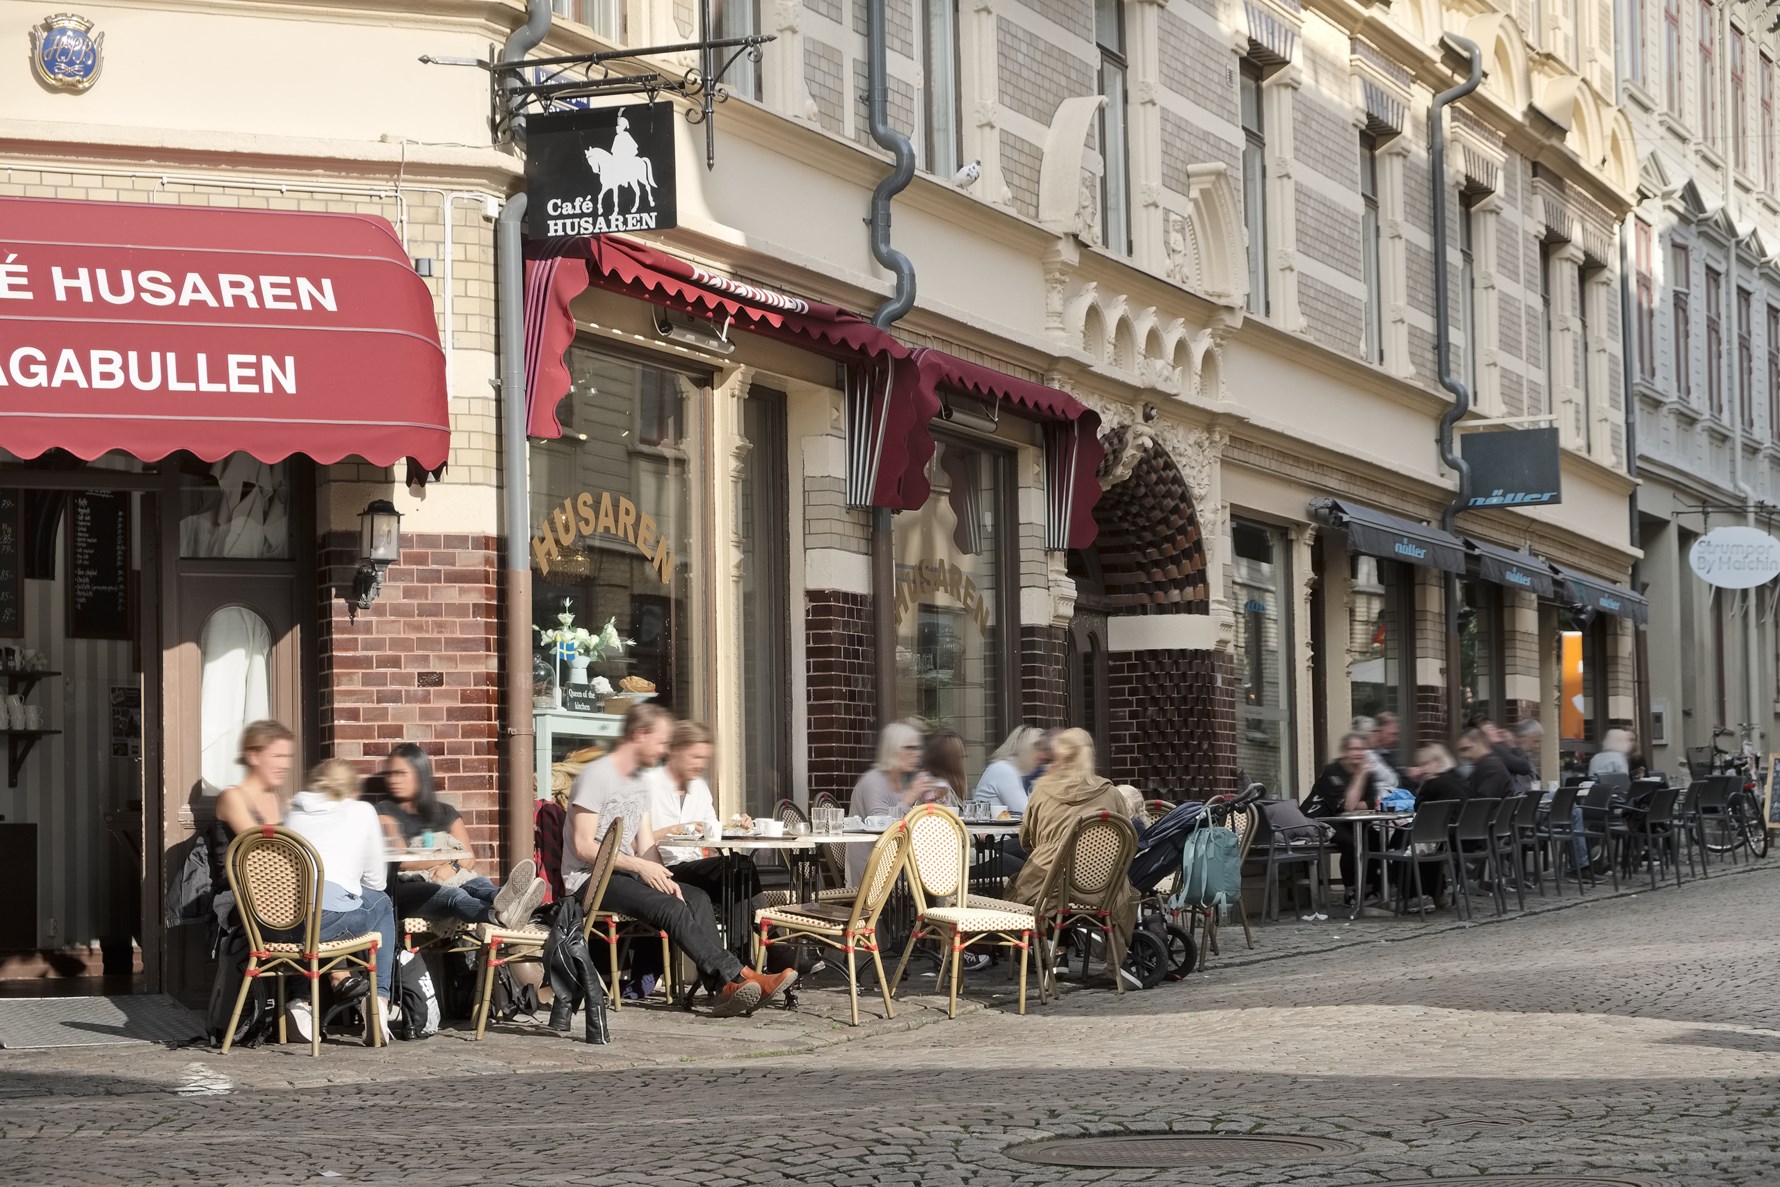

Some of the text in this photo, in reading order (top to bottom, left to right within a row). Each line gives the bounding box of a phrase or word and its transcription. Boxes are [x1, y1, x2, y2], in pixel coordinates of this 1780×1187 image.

[546, 195, 593, 216] Café
[546, 212, 658, 237] HUSAREN
[51, 266, 338, 312] HUSAREN
[0, 346, 297, 394] GABULLEN
[1468, 488, 1559, 506] nöller
[531, 491, 676, 584] HUSAREN
[1395, 537, 1427, 559] nöller
[1697, 540, 1775, 559] Strumpor
[1697, 556, 1715, 574] By
[894, 558, 990, 638] HUSAREN
[568, 688, 596, 699] Queen of the
[574, 701, 591, 711] kitchen
